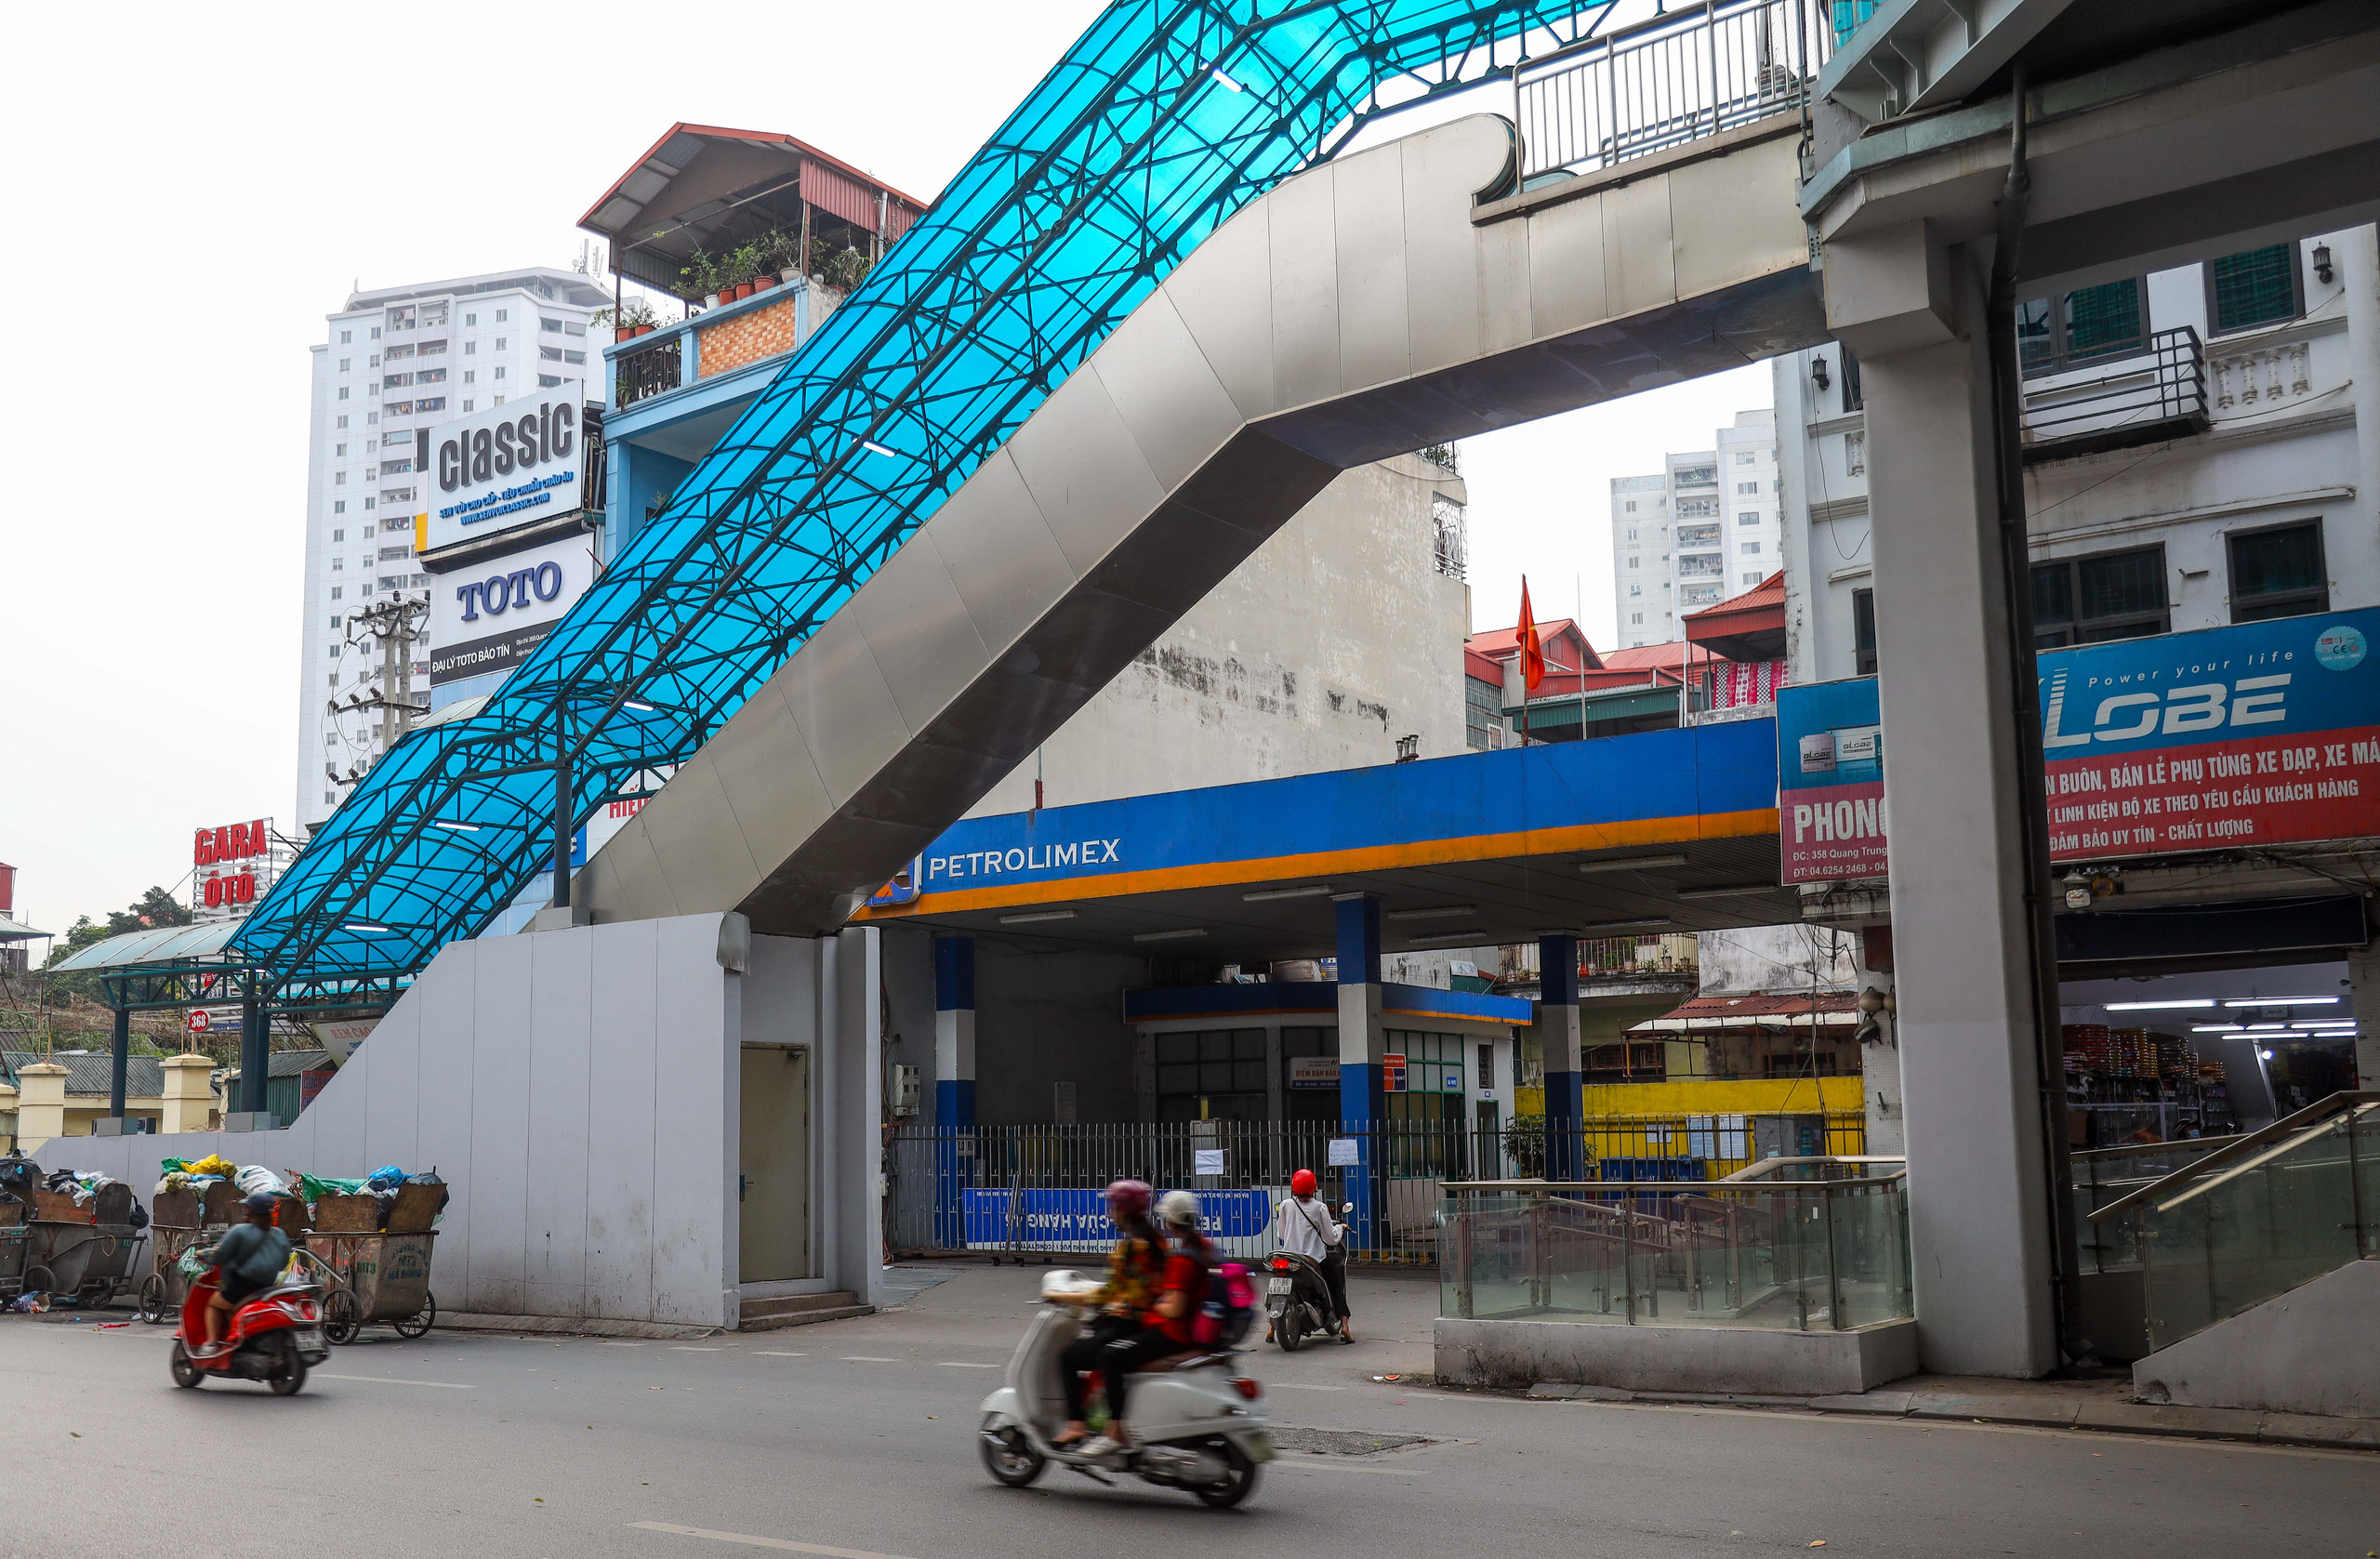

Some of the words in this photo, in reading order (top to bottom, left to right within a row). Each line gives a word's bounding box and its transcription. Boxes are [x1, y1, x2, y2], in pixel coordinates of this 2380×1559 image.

[467, 499, 483, 510] CAO
[456, 561, 562, 621] TOTO
[432, 659, 446, 674] ĐẠI
[447, 655, 456, 669] LÝ
[456, 653, 478, 667] TOTO
[496, 643, 510, 658] TÍN
[2088, 669, 2159, 688] Power
[2175, 660, 2230, 679] your
[2248, 651, 2294, 667] life
[2059, 767, 2107, 792] BUÔN,
[2110, 762, 2144, 788] BÁN
[2148, 756, 2166, 785] LẺ
[2170, 759, 2203, 785] PHỤ
[2207, 752, 2252, 778] TÙNG
[2254, 751, 2278, 774] XE
[2281, 746, 2320, 774] ĐẠP,
[2324, 744, 2347, 768] XE
[2055, 806, 2083, 824] LINH
[2087, 799, 2119, 822] KIỆN
[2122, 797, 2140, 818] ĐỘ
[2144, 797, 2161, 814] XE
[2163, 794, 2199, 813] THEO
[2202, 788, 2228, 810] YÊU
[2233, 784, 2261, 807] CẦU
[2265, 782, 2314, 804] KHÁCH
[2317, 777, 2359, 799] HÀNG
[195, 819, 267, 865] GARA
[2049, 831, 2079, 852] ĐẢM
[2082, 827, 2109, 848] BẢO
[2112, 828, 2132, 845] UY
[2133, 826, 2155, 843] TÍN
[2168, 818, 2203, 840] CHẤT
[2207, 818, 2254, 839] LƯỢNG
[929, 838, 1120, 880] PETROLIMEX
[1793, 852, 1809, 861] ĐC:
[1812, 850, 1827, 859] 358
[1830, 849, 1859, 858] Quang
[1861, 847, 1887, 856] Trung
[1793, 867, 1807, 878] ĐT:
[1810, 865, 1843, 875] 04.6254
[1846, 864, 1867, 874] 2468
[205, 865, 255, 907] ÔTÔ
[192, 1014, 206, 1028] 368
[1027, 1213, 1071, 1232] HÀNG
